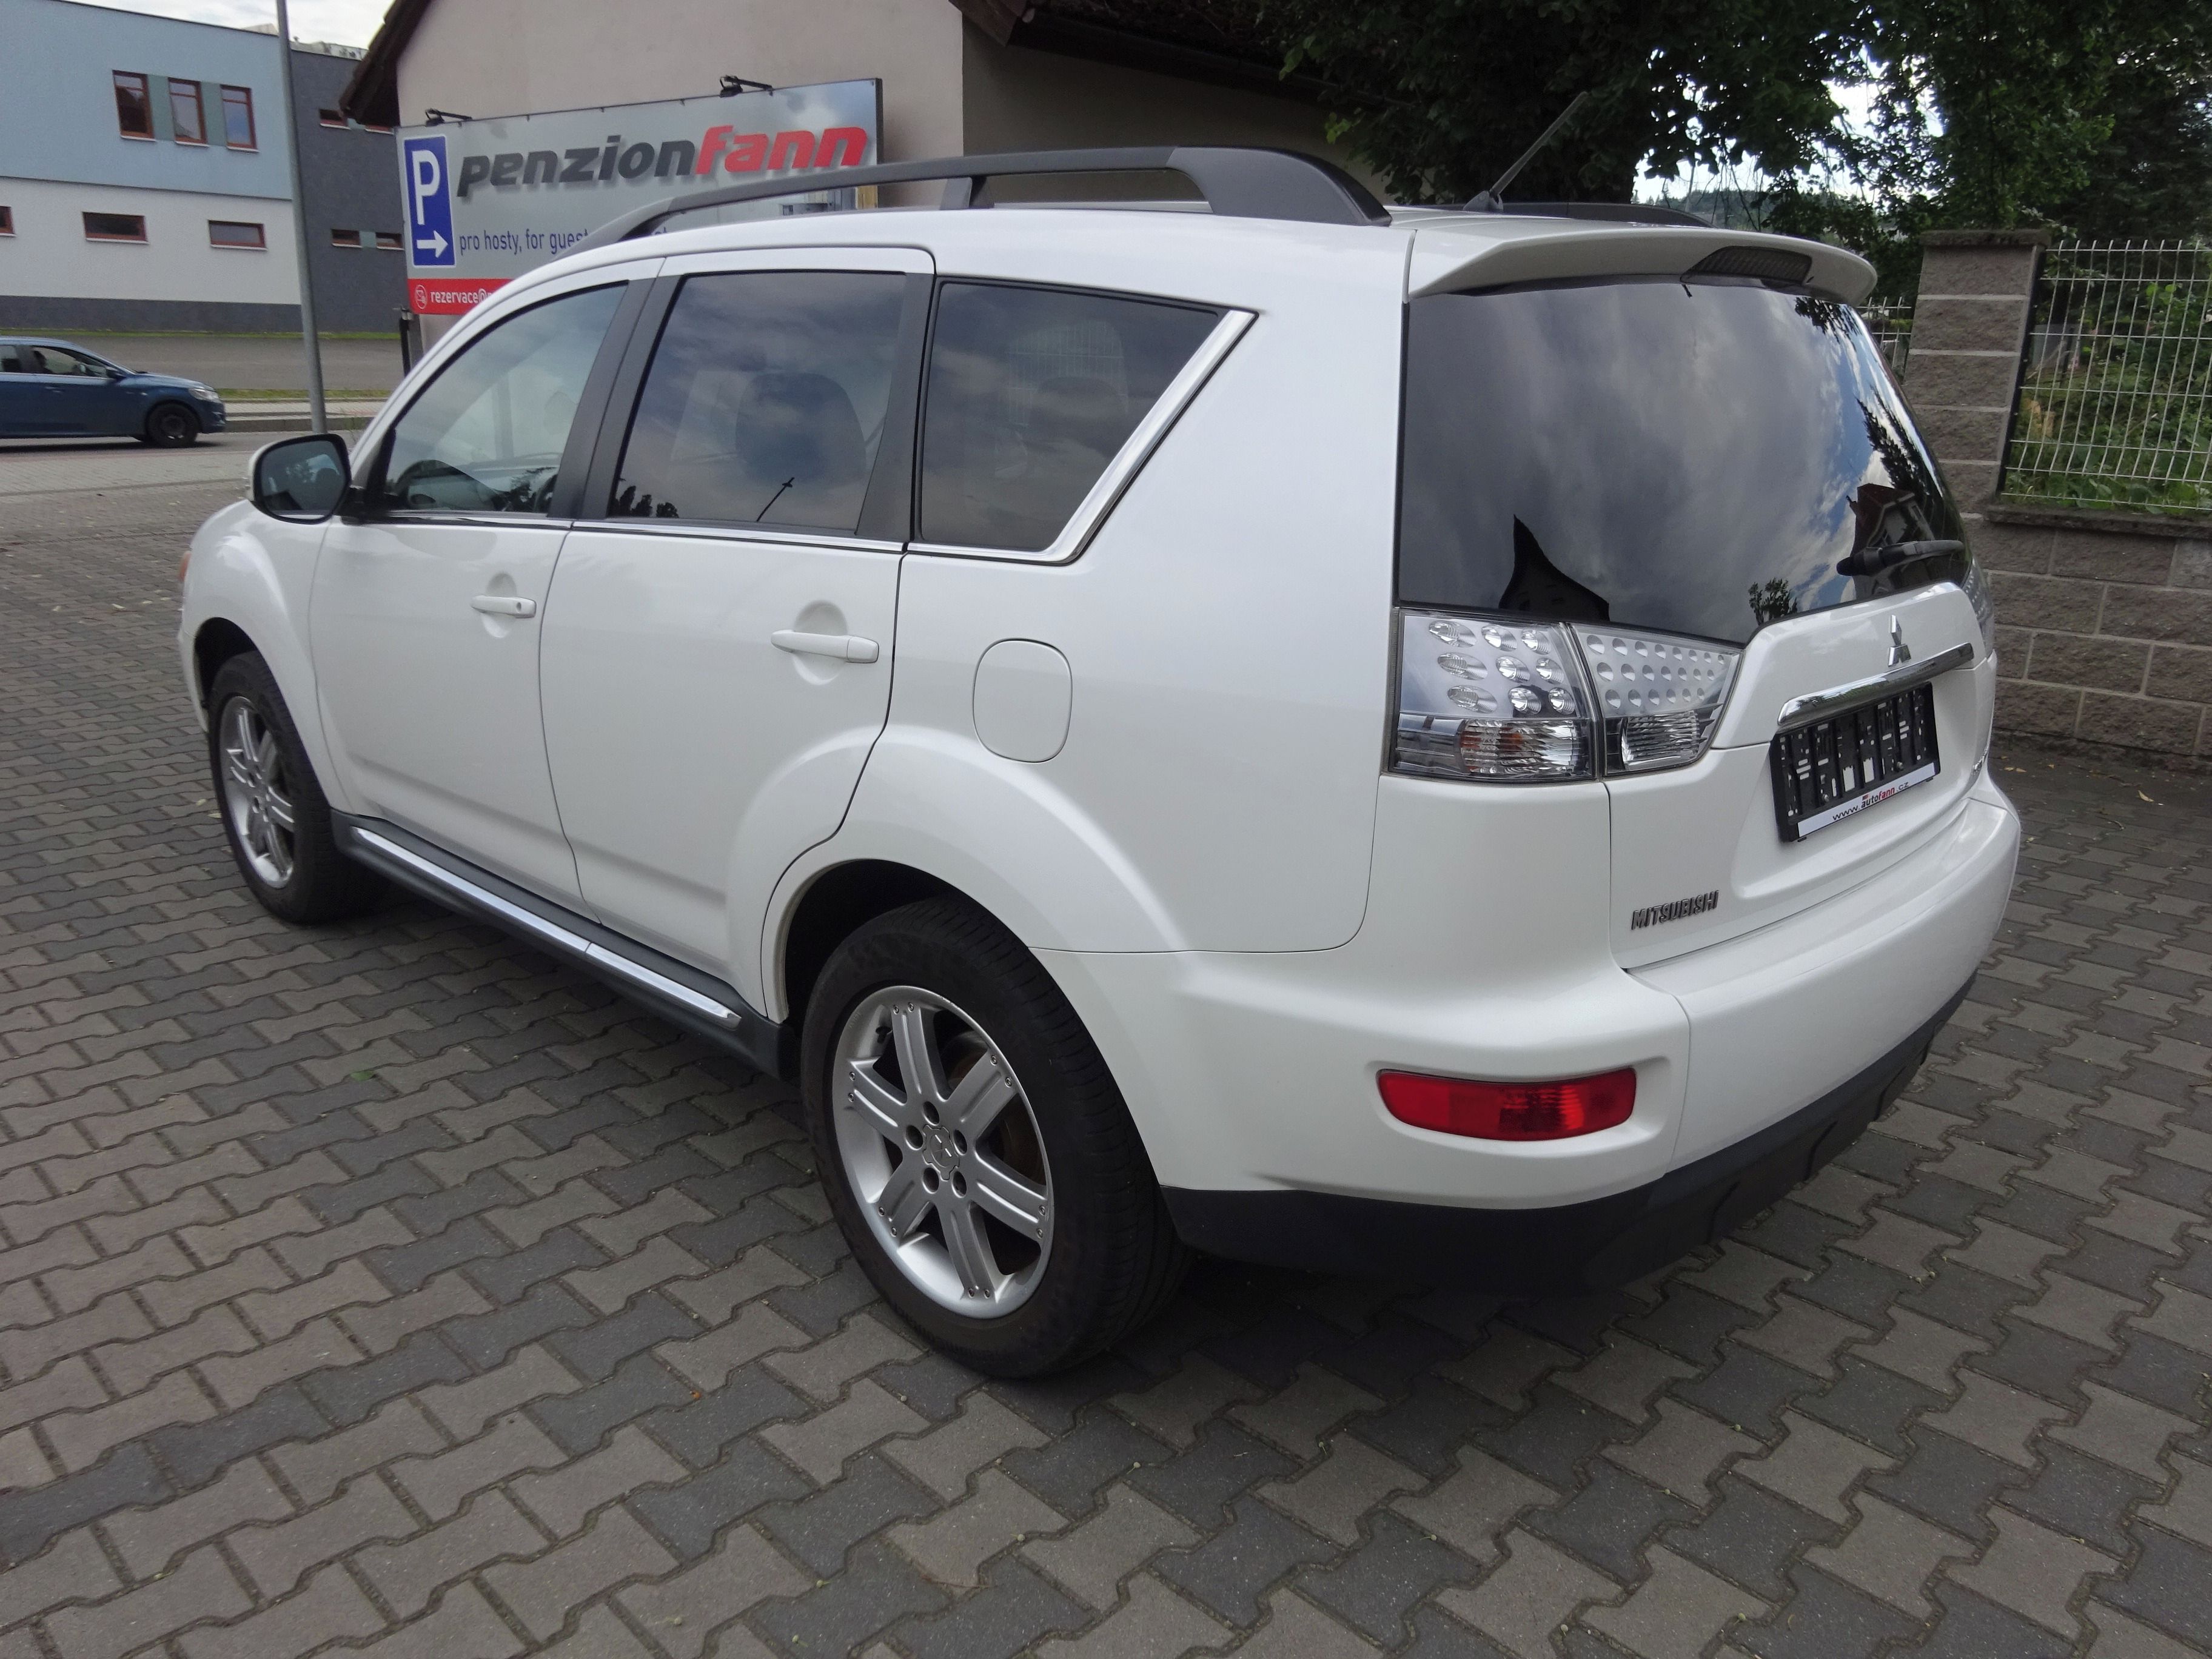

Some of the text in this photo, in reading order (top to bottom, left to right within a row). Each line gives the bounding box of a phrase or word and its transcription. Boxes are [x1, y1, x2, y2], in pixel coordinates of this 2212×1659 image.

[457, 125, 867, 197] penzionfann
[412, 149, 441, 225] P
[459, 233, 480, 255] pro
[484, 229, 521, 255] hosty,
[526, 228, 543, 249] for
[1832, 782, 1909, 820] www.autofann.cz
[1631, 890, 1720, 930] MITSUBISHI
